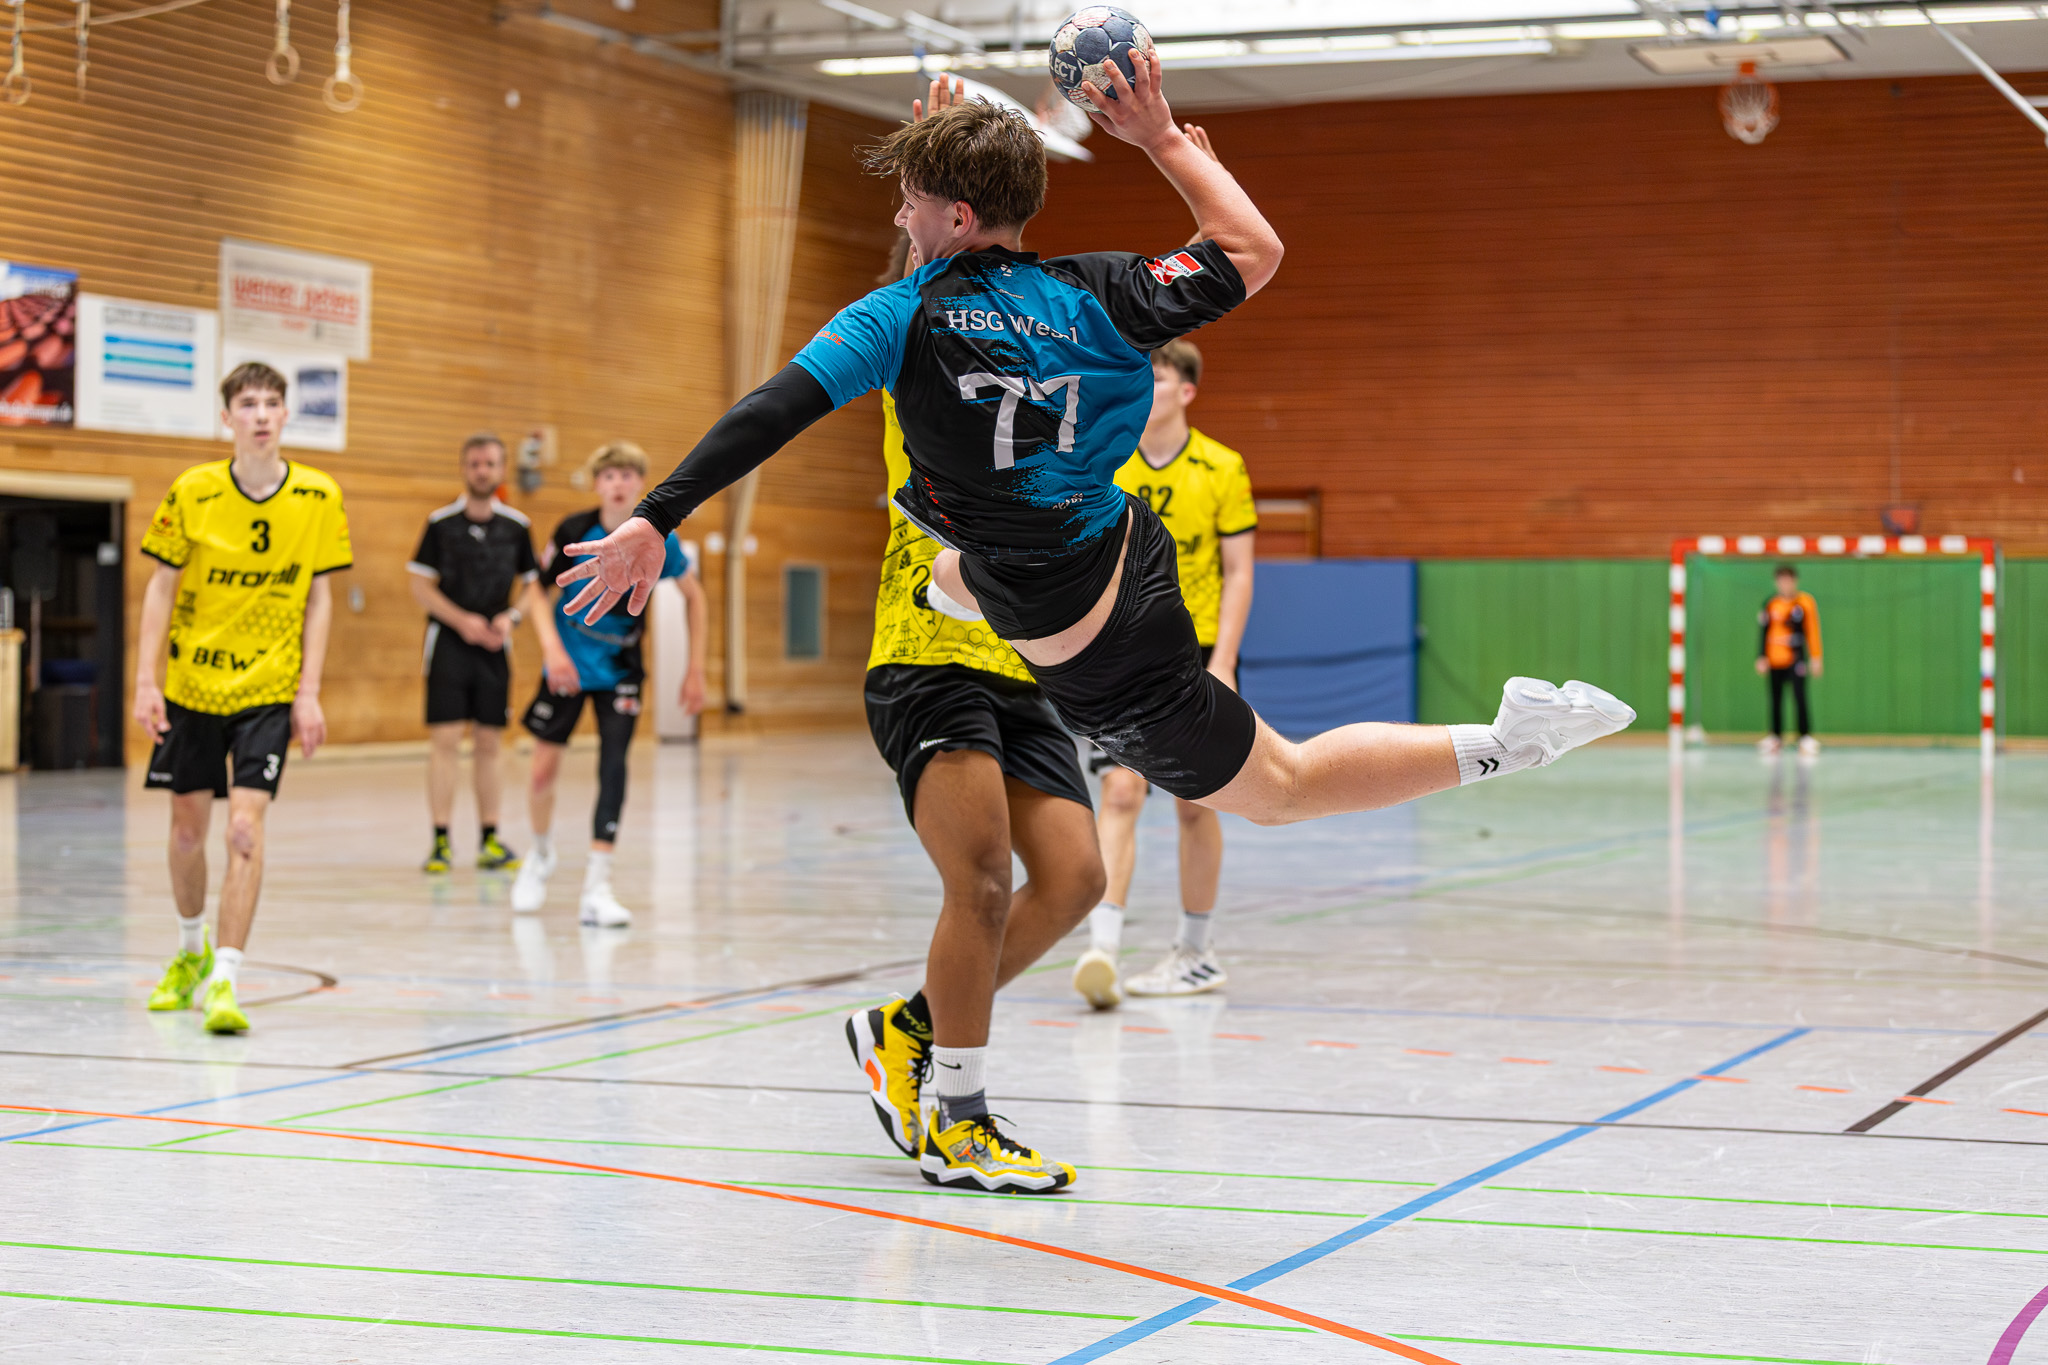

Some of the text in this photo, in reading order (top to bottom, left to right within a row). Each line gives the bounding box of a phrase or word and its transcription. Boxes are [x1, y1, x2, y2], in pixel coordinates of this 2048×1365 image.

[946, 309, 1005, 332] HSG
[957, 372, 1083, 471] 77
[1138, 485, 1174, 517] 82
[251, 520, 270, 553] 3
[262, 753, 281, 781] 3
